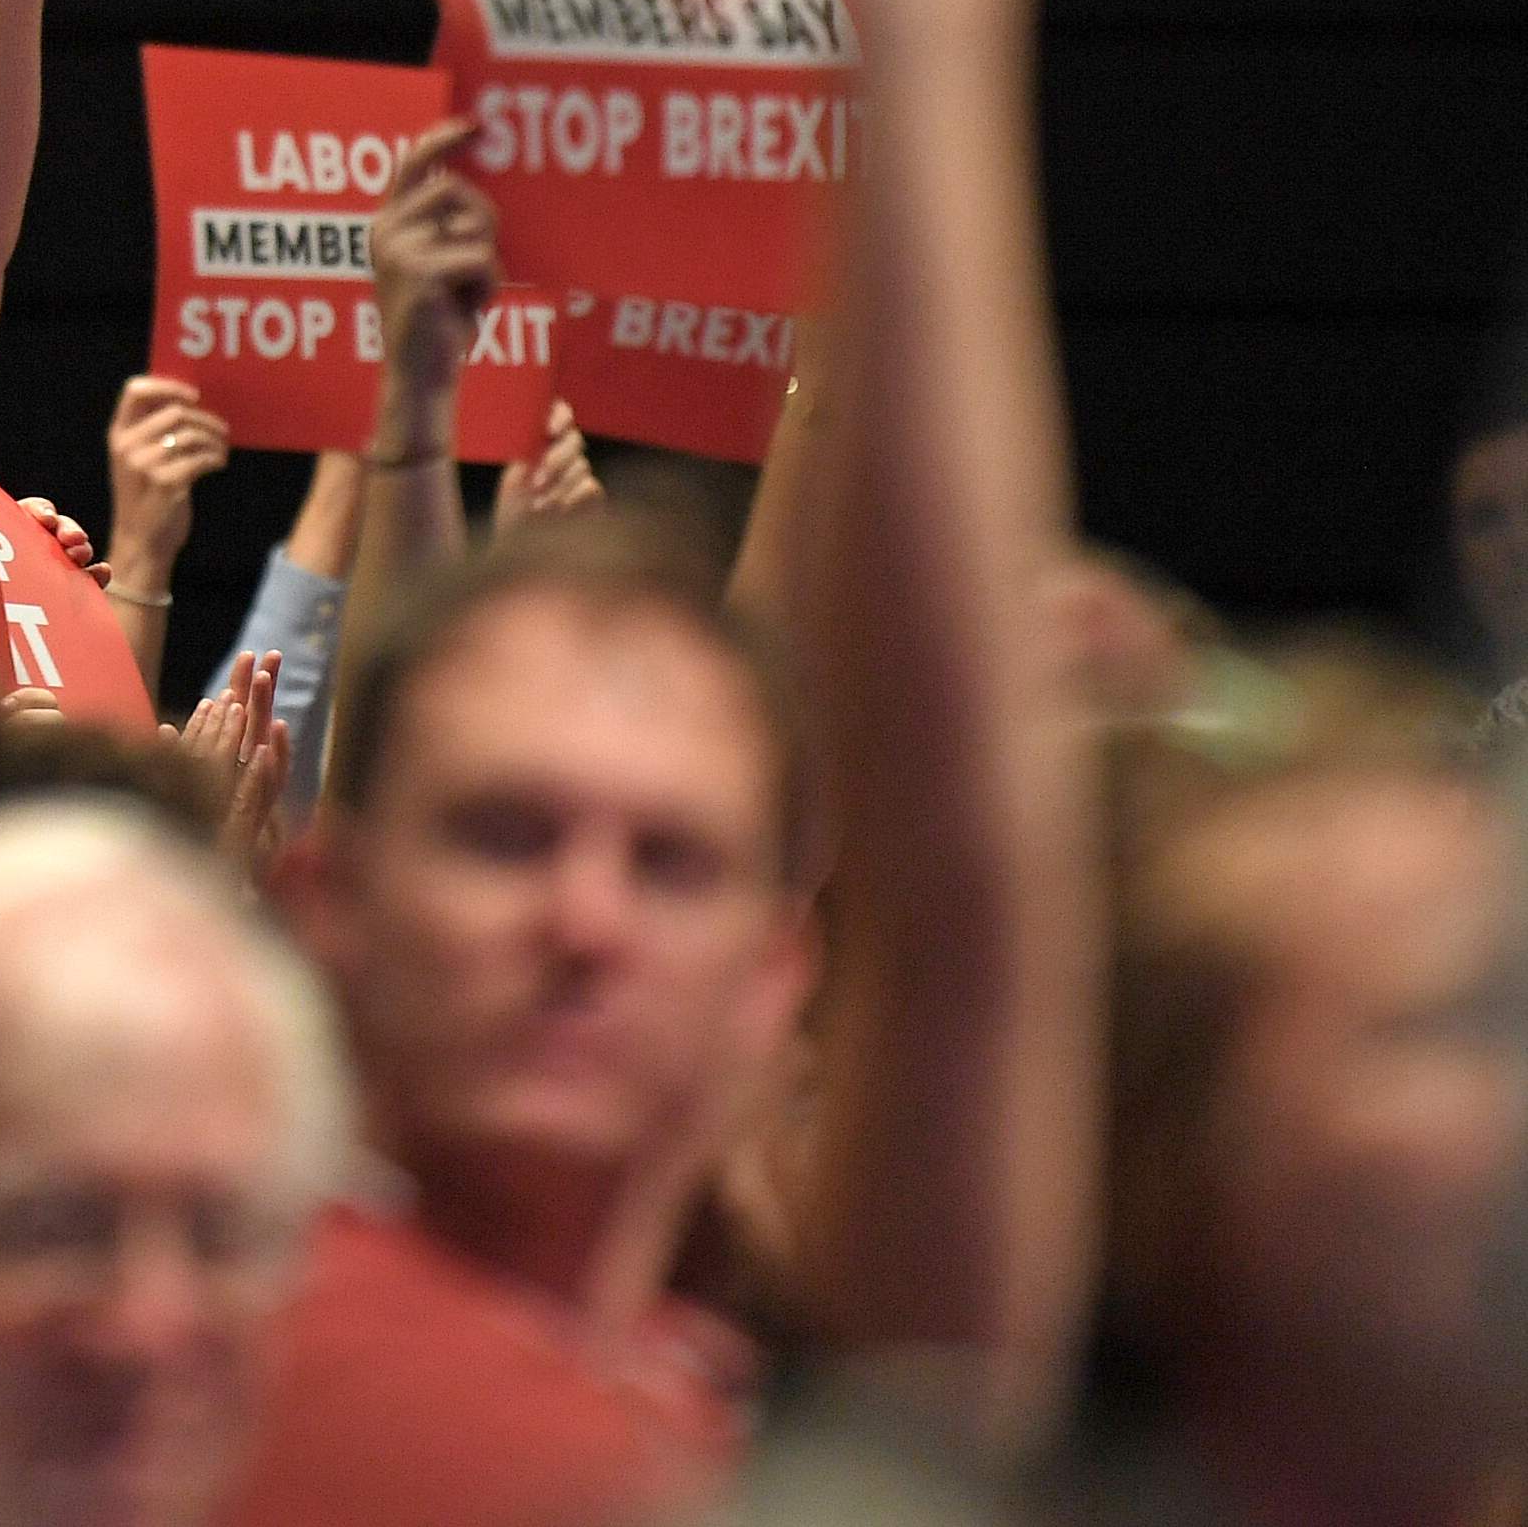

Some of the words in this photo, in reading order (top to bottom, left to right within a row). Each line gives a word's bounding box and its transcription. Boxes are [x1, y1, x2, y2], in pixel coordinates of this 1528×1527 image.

[238, 129, 411, 196] LABO
[474, 84, 644, 176] STOP
[661, 87, 855, 182] BREXI
[203, 220, 371, 268] MEMBE
[178, 295, 336, 361] STOP
[354, 298, 556, 367] BXIT
[611, 295, 795, 371] BREXI
